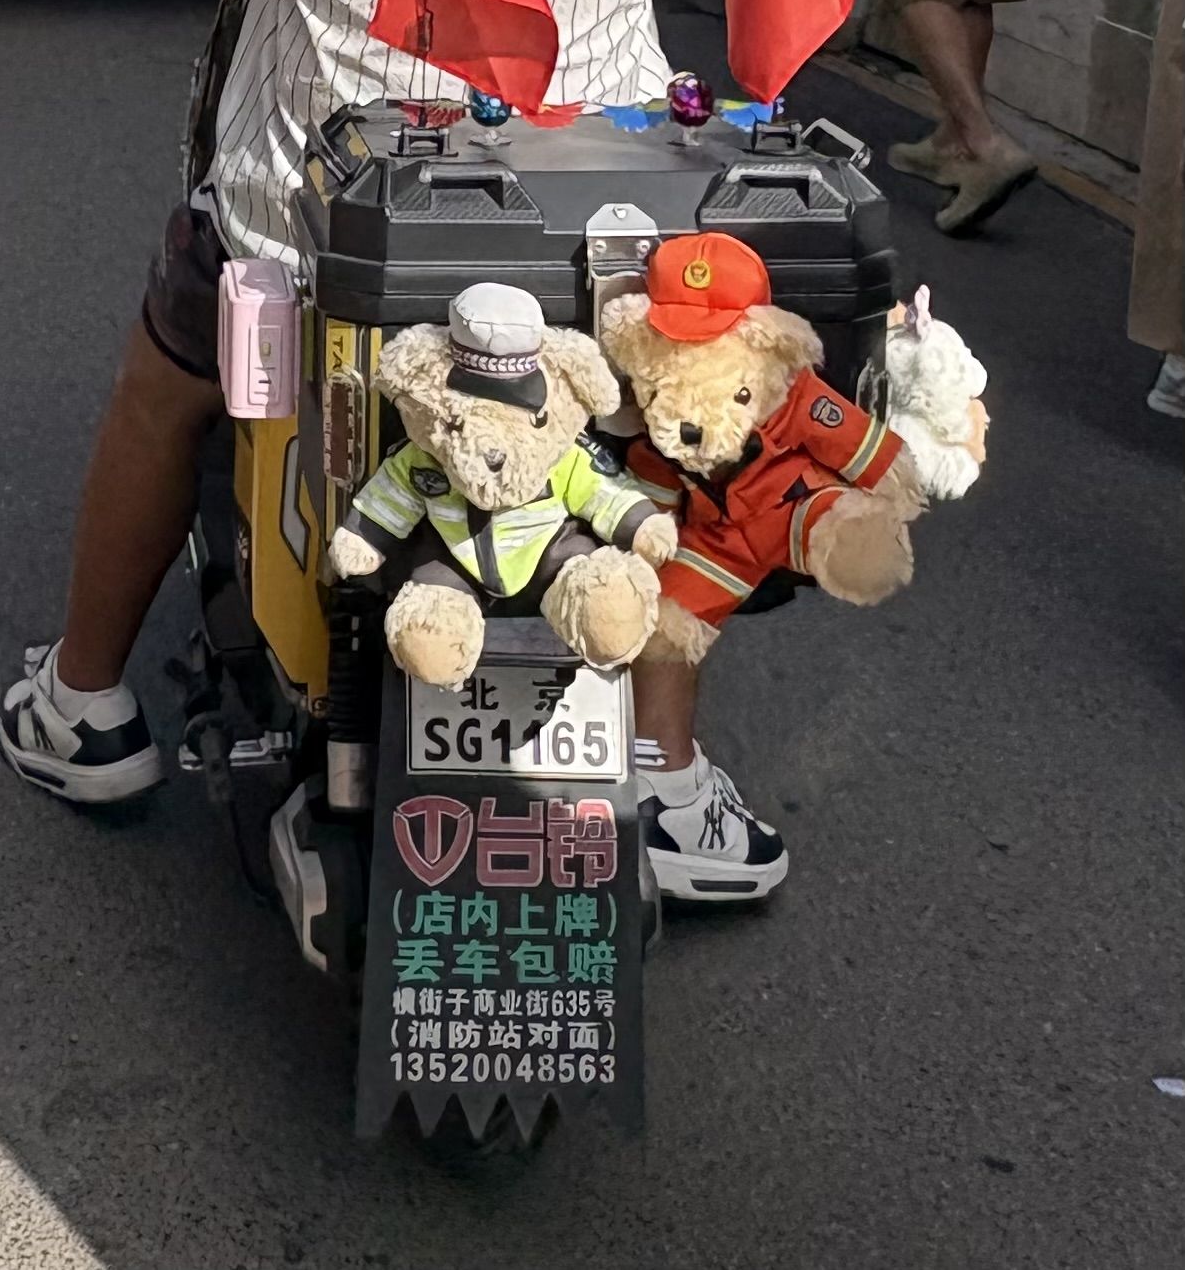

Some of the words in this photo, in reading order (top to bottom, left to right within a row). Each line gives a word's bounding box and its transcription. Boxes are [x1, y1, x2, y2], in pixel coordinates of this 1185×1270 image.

[460, 672, 571, 712] 北京
[424, 716, 610, 767] SG1165
[476, 796, 618, 889] 台铃
[392, 938, 618, 985] 丢车包赔
[390, 1051, 616, 1084] 13520048563
